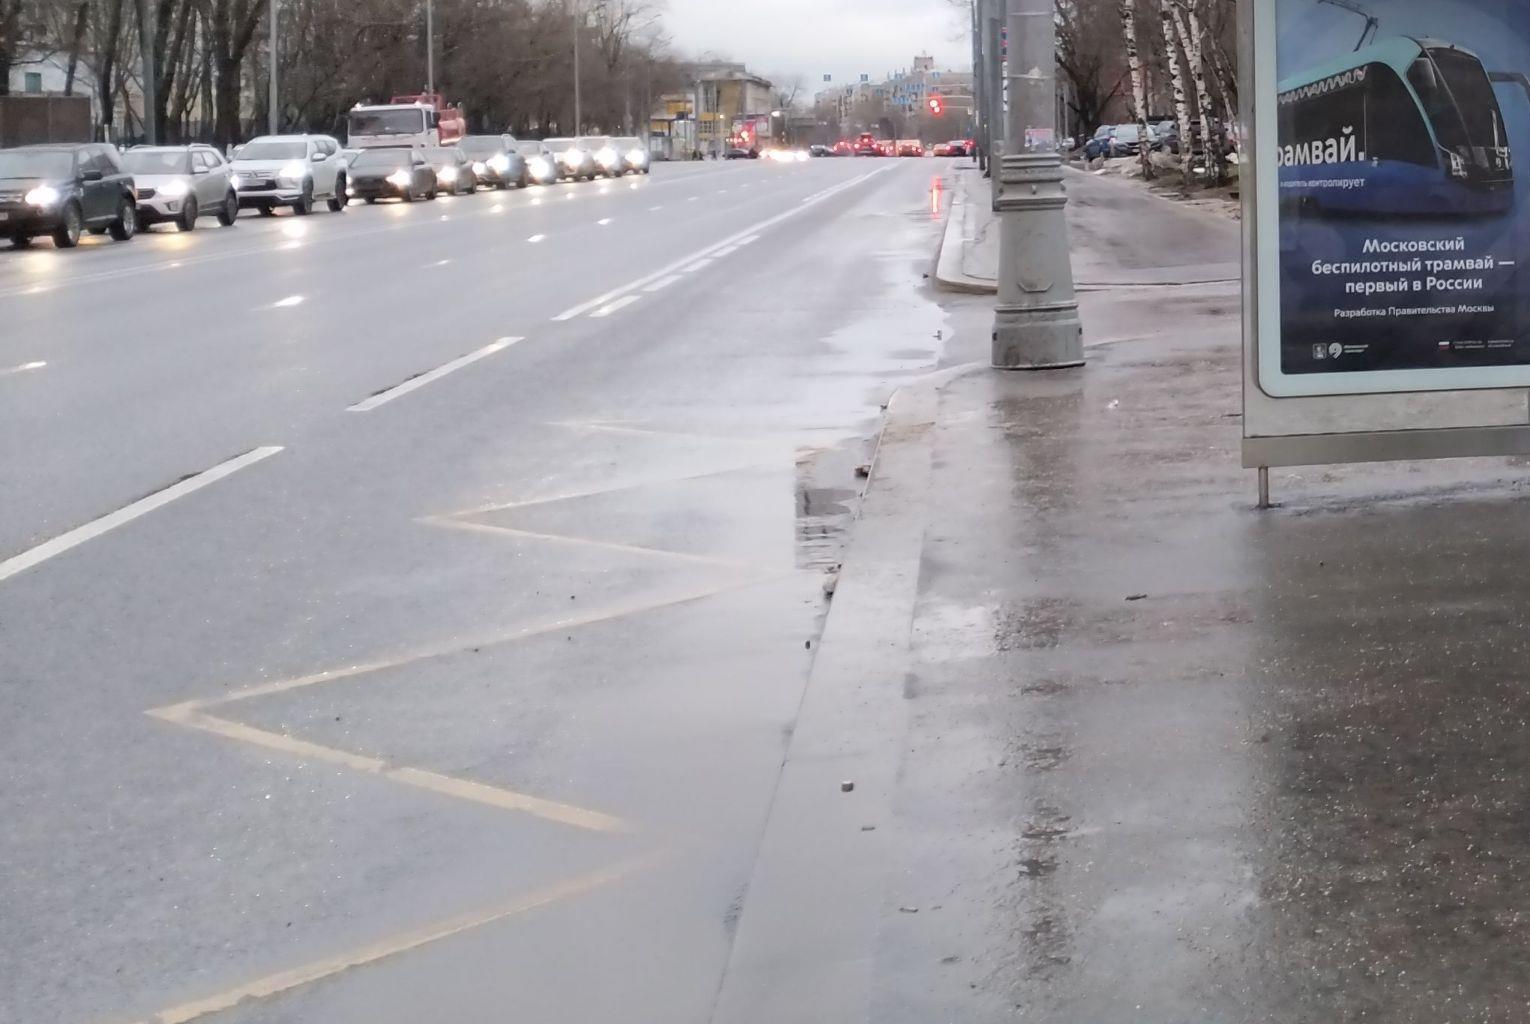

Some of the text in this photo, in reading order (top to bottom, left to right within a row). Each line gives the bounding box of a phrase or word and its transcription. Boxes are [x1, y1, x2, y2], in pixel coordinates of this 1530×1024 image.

[1362, 236, 1465, 253] Московский
[1311, 258, 1421, 275] беспилотный
[1424, 255, 1494, 273] трамвай
[1345, 276, 1483, 296] первый в России
[1334, 304, 1495, 318] Разработка Правительства Москвы
